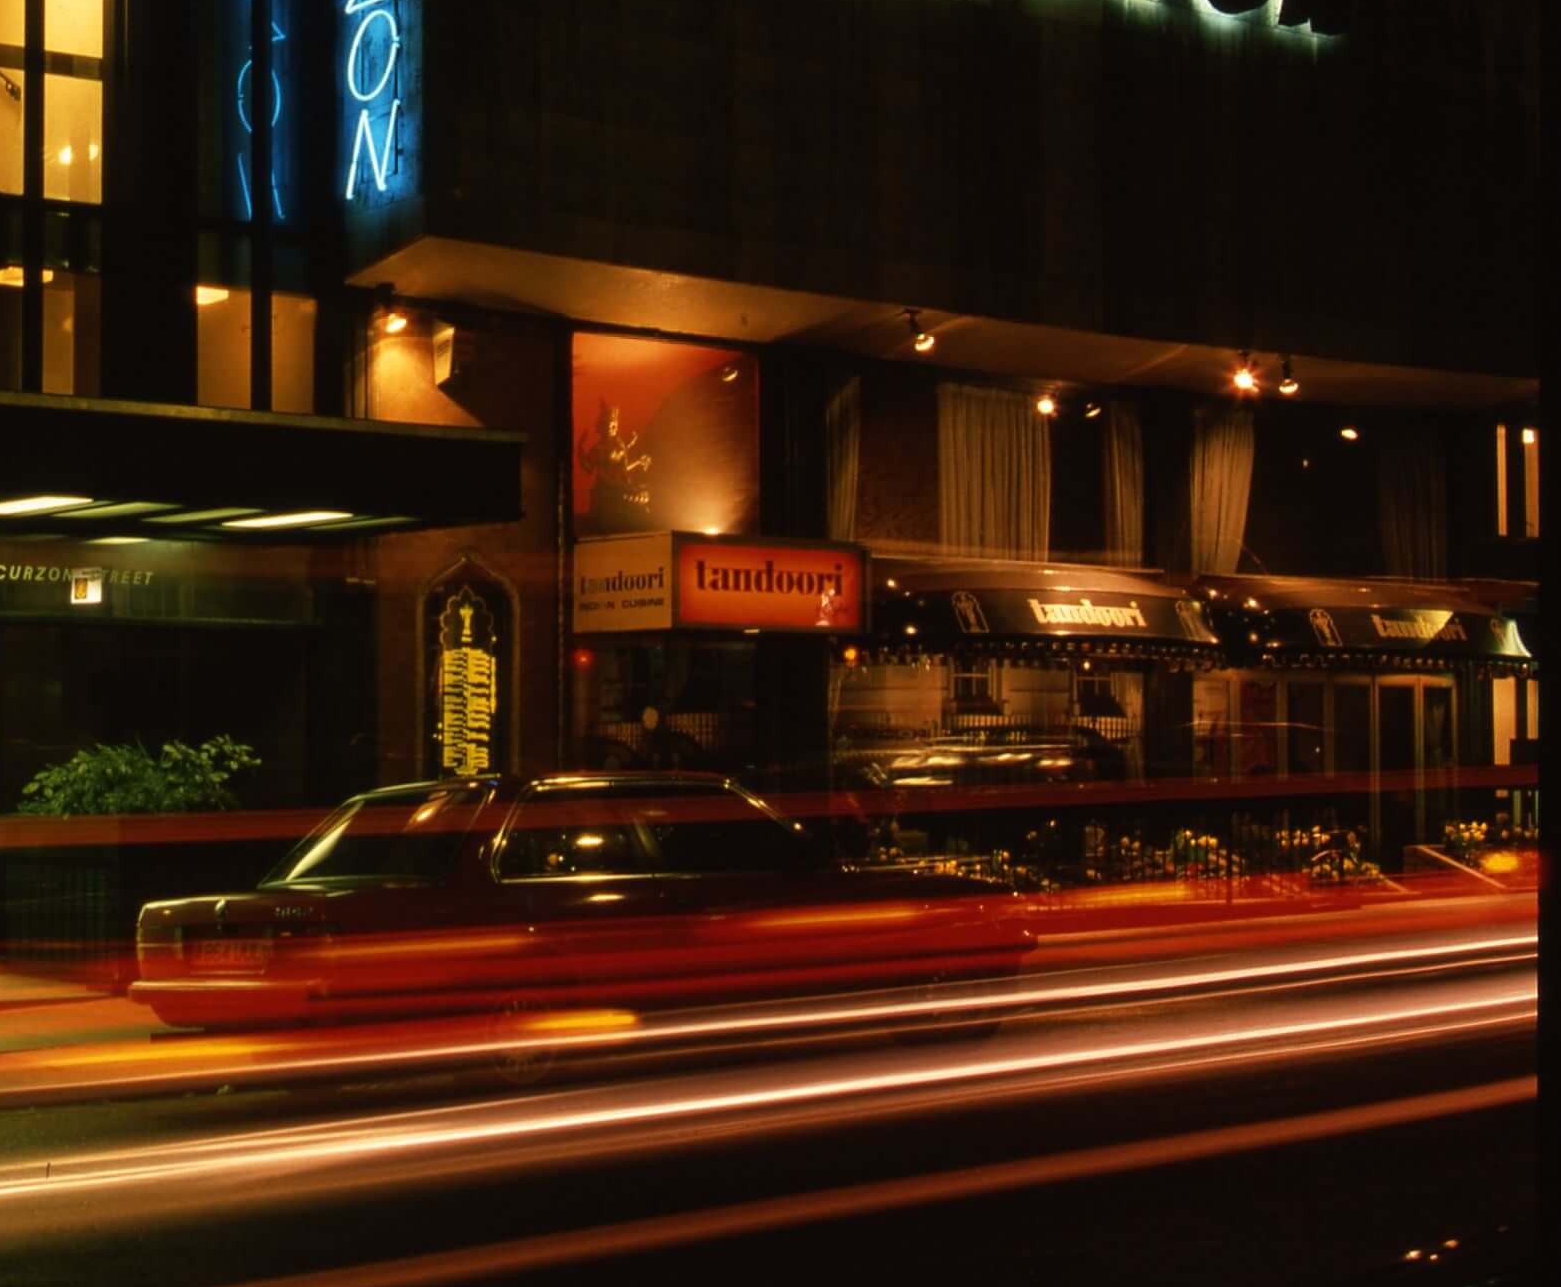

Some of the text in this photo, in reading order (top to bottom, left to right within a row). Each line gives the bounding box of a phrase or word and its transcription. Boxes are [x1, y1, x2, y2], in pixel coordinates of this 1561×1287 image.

[91, 568, 155, 586] TREET
[696, 559, 844, 596] tandoori
[1027, 598, 1149, 627] tandoori
